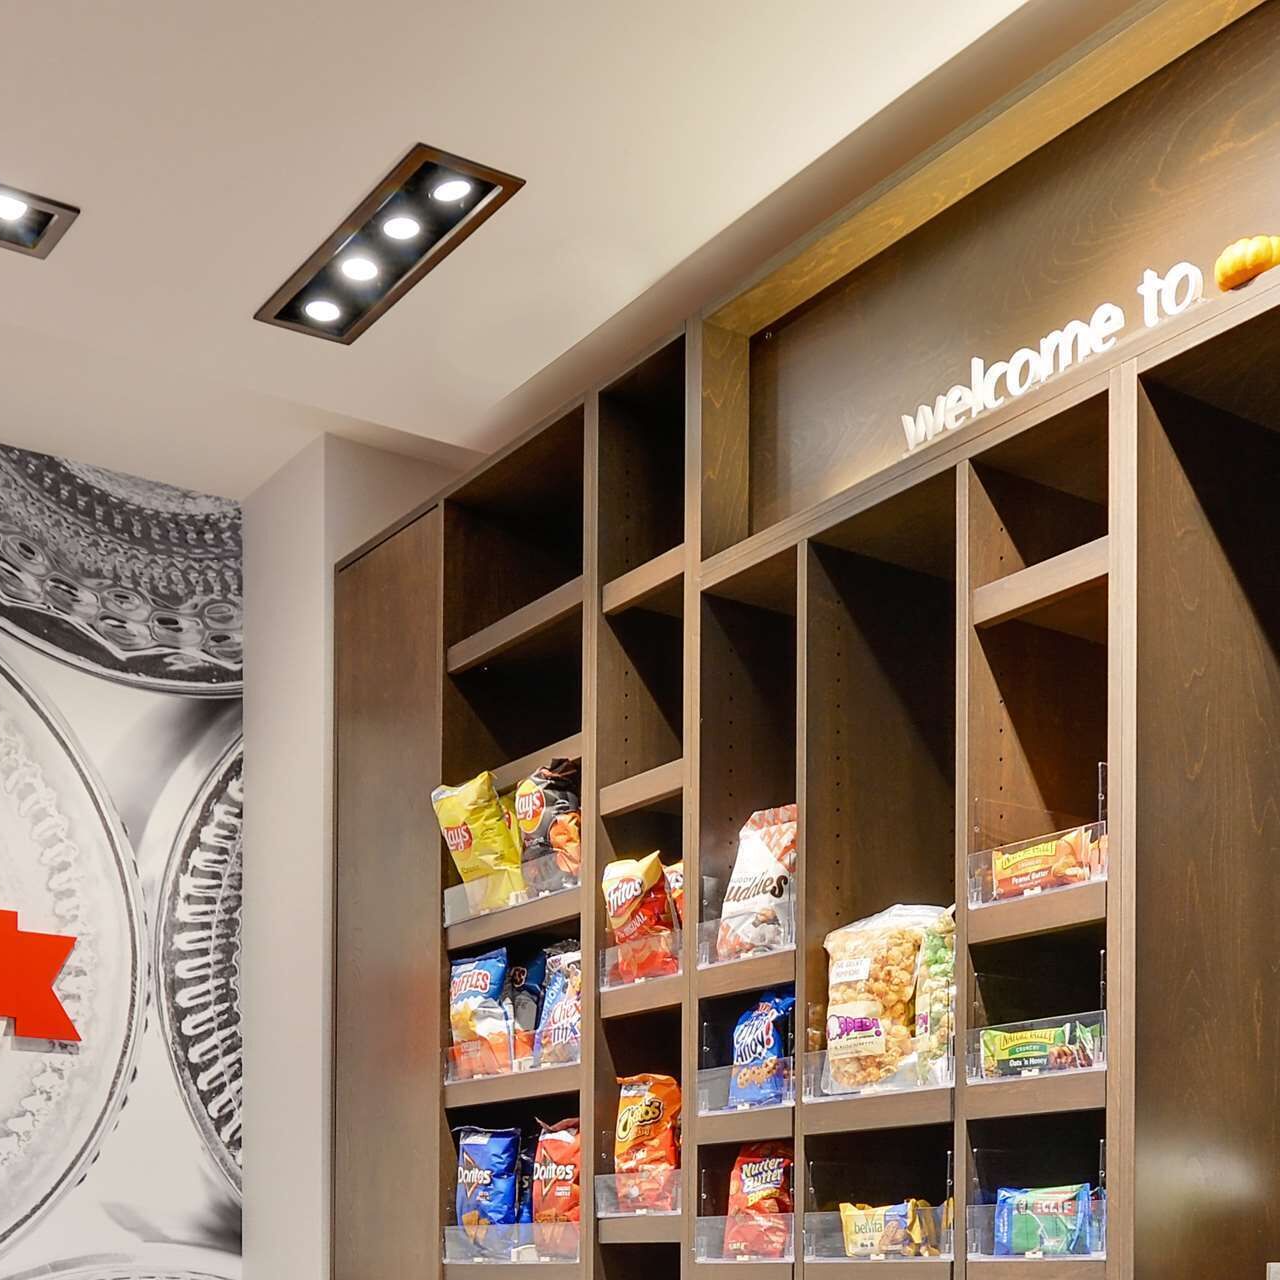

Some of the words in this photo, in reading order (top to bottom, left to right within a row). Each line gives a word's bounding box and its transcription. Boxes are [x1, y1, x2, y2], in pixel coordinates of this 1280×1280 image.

[901, 302, 1126, 452] welcome
[1137, 262, 1204, 328] to
[458, 1167, 491, 1184] Doritos
[533, 1162, 576, 1182] Doritos
[742, 1158, 784, 1180] Nutter
[743, 1168, 784, 1193] Butter
